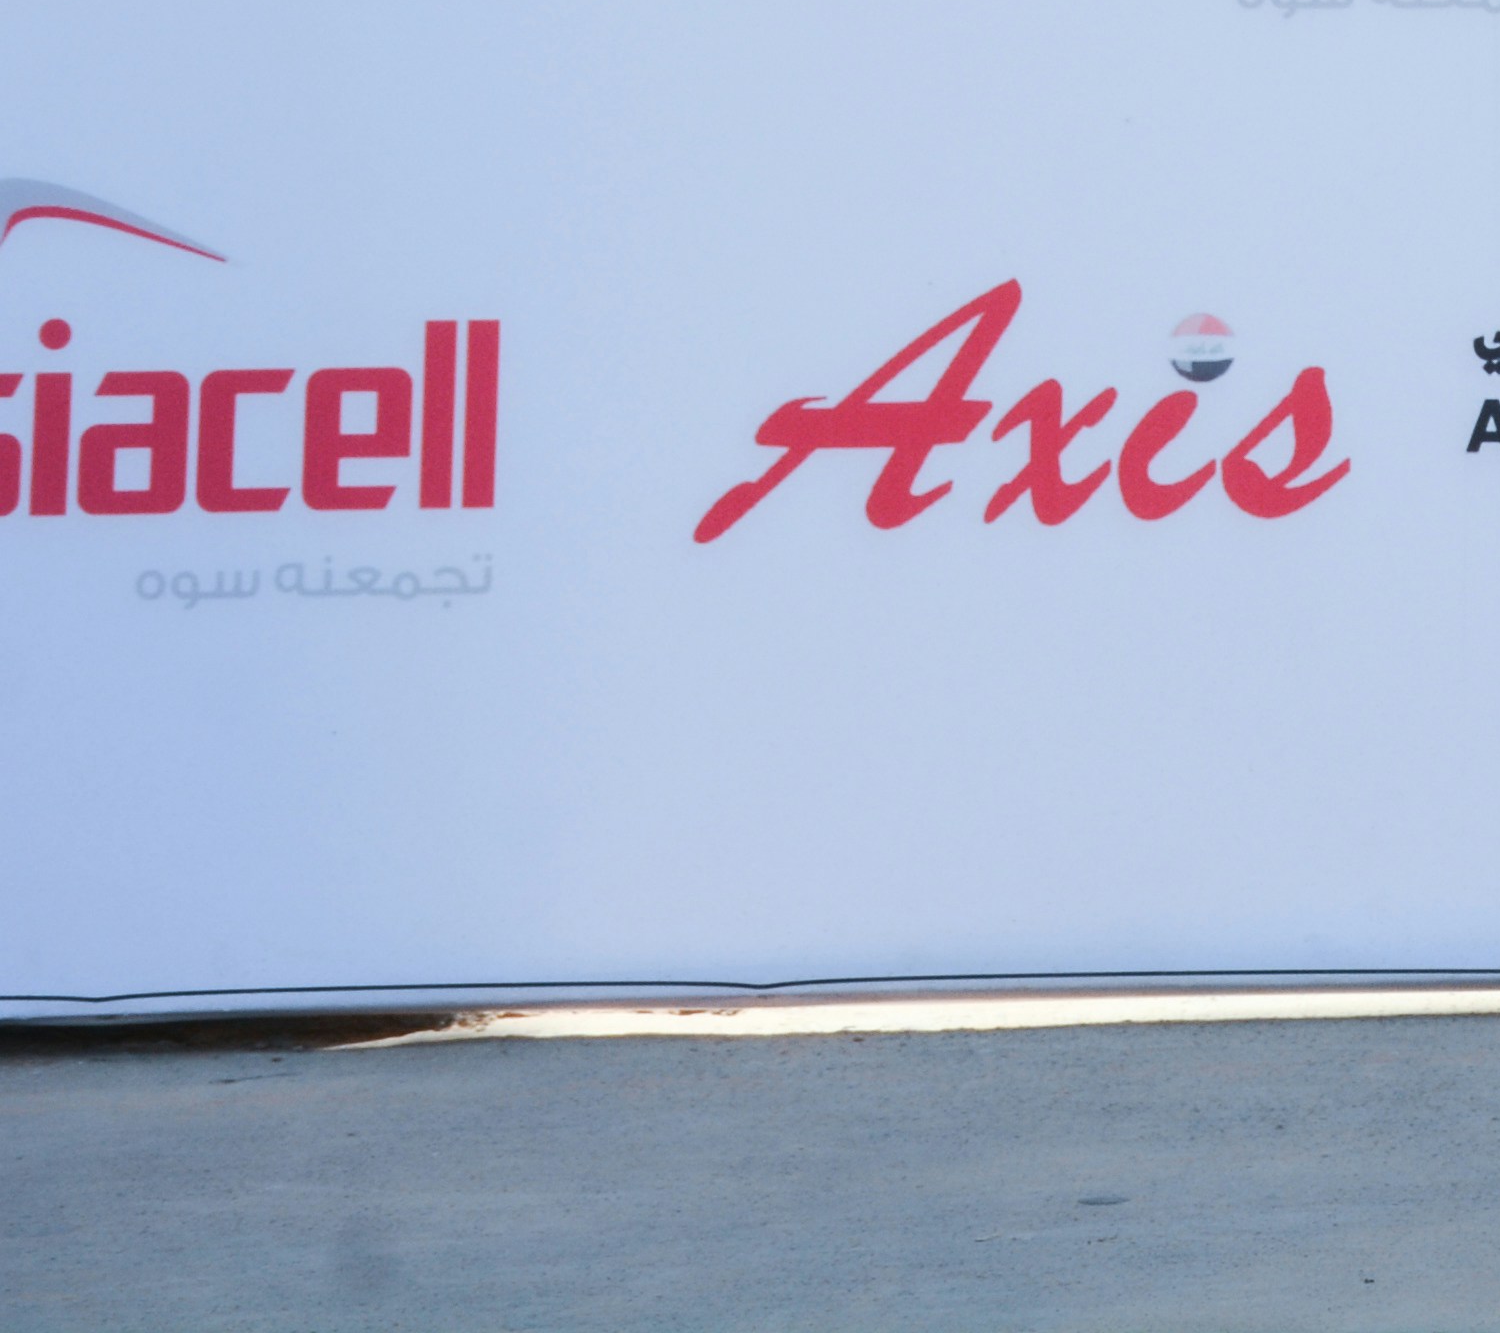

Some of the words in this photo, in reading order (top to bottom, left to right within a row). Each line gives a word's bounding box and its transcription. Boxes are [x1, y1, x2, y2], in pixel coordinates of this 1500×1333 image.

[0, 319, 499, 517] iacell
[693, 278, 1351, 544] Axis
[136, 571, 259, 609] سوه
